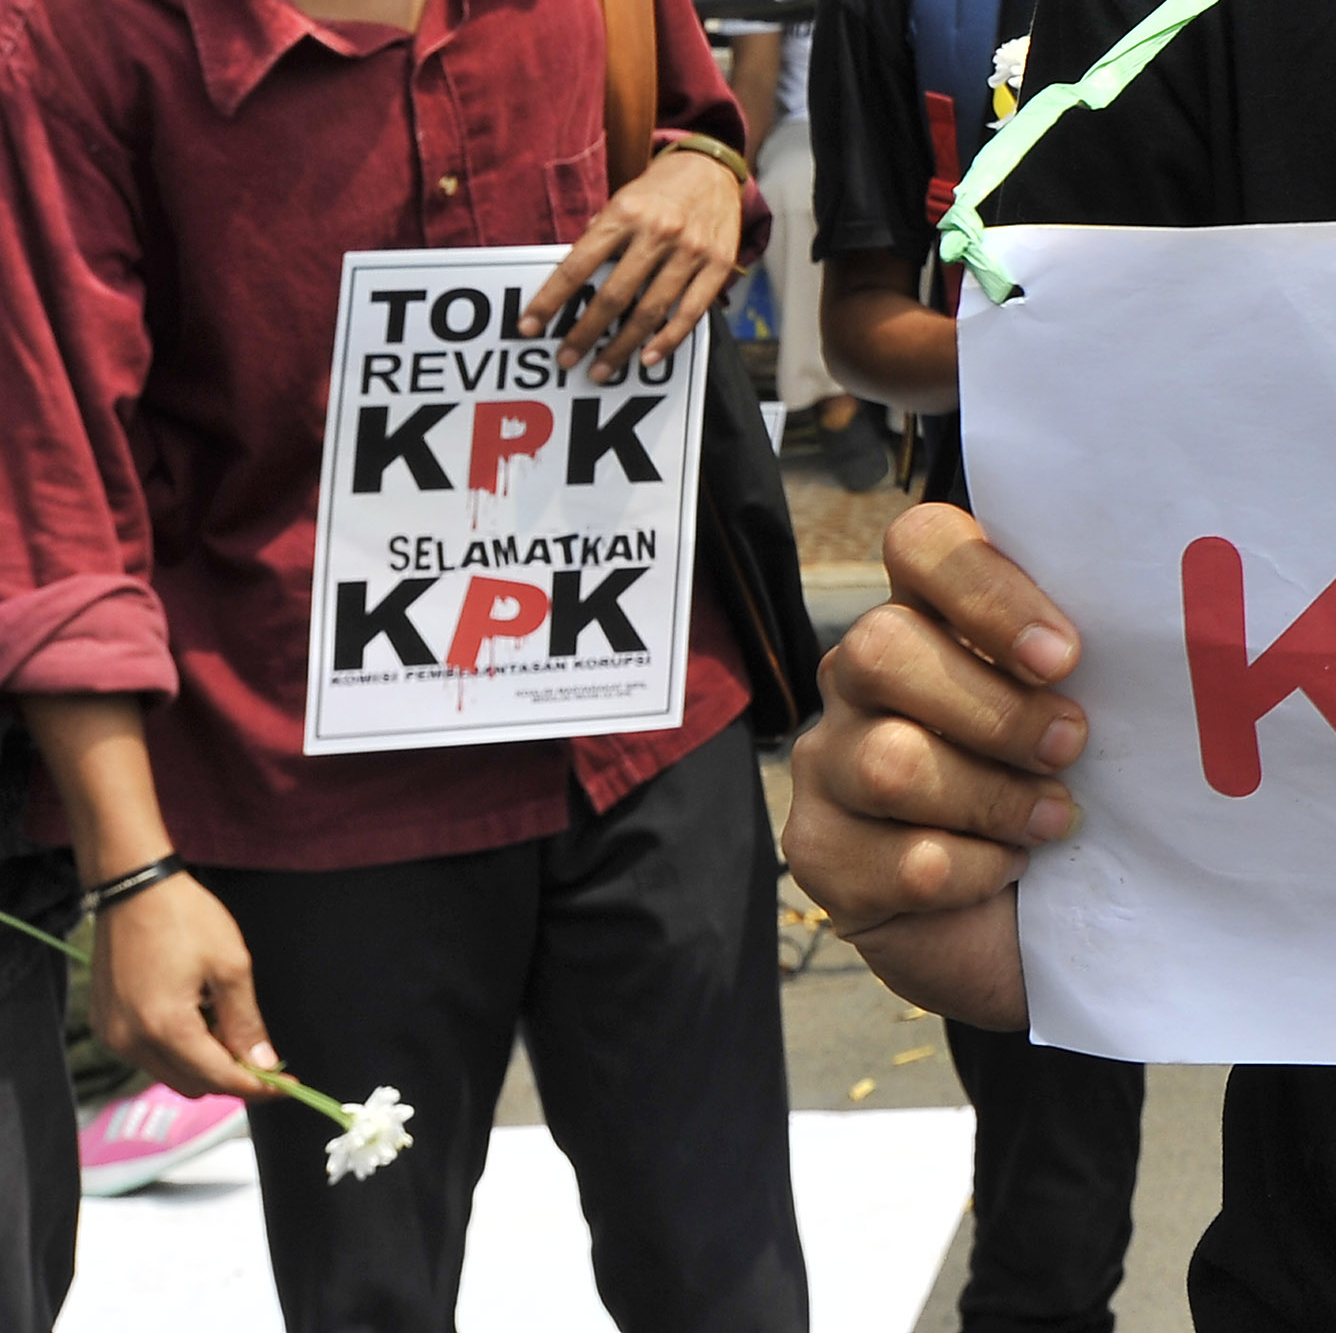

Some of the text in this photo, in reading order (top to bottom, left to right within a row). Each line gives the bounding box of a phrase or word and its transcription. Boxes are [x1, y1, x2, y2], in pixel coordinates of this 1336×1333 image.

[369, 286, 669, 343] TOLA
[351, 395, 668, 494] KPK
[389, 529, 657, 572] SELAMATKAN
[333, 567, 652, 674] KPK
